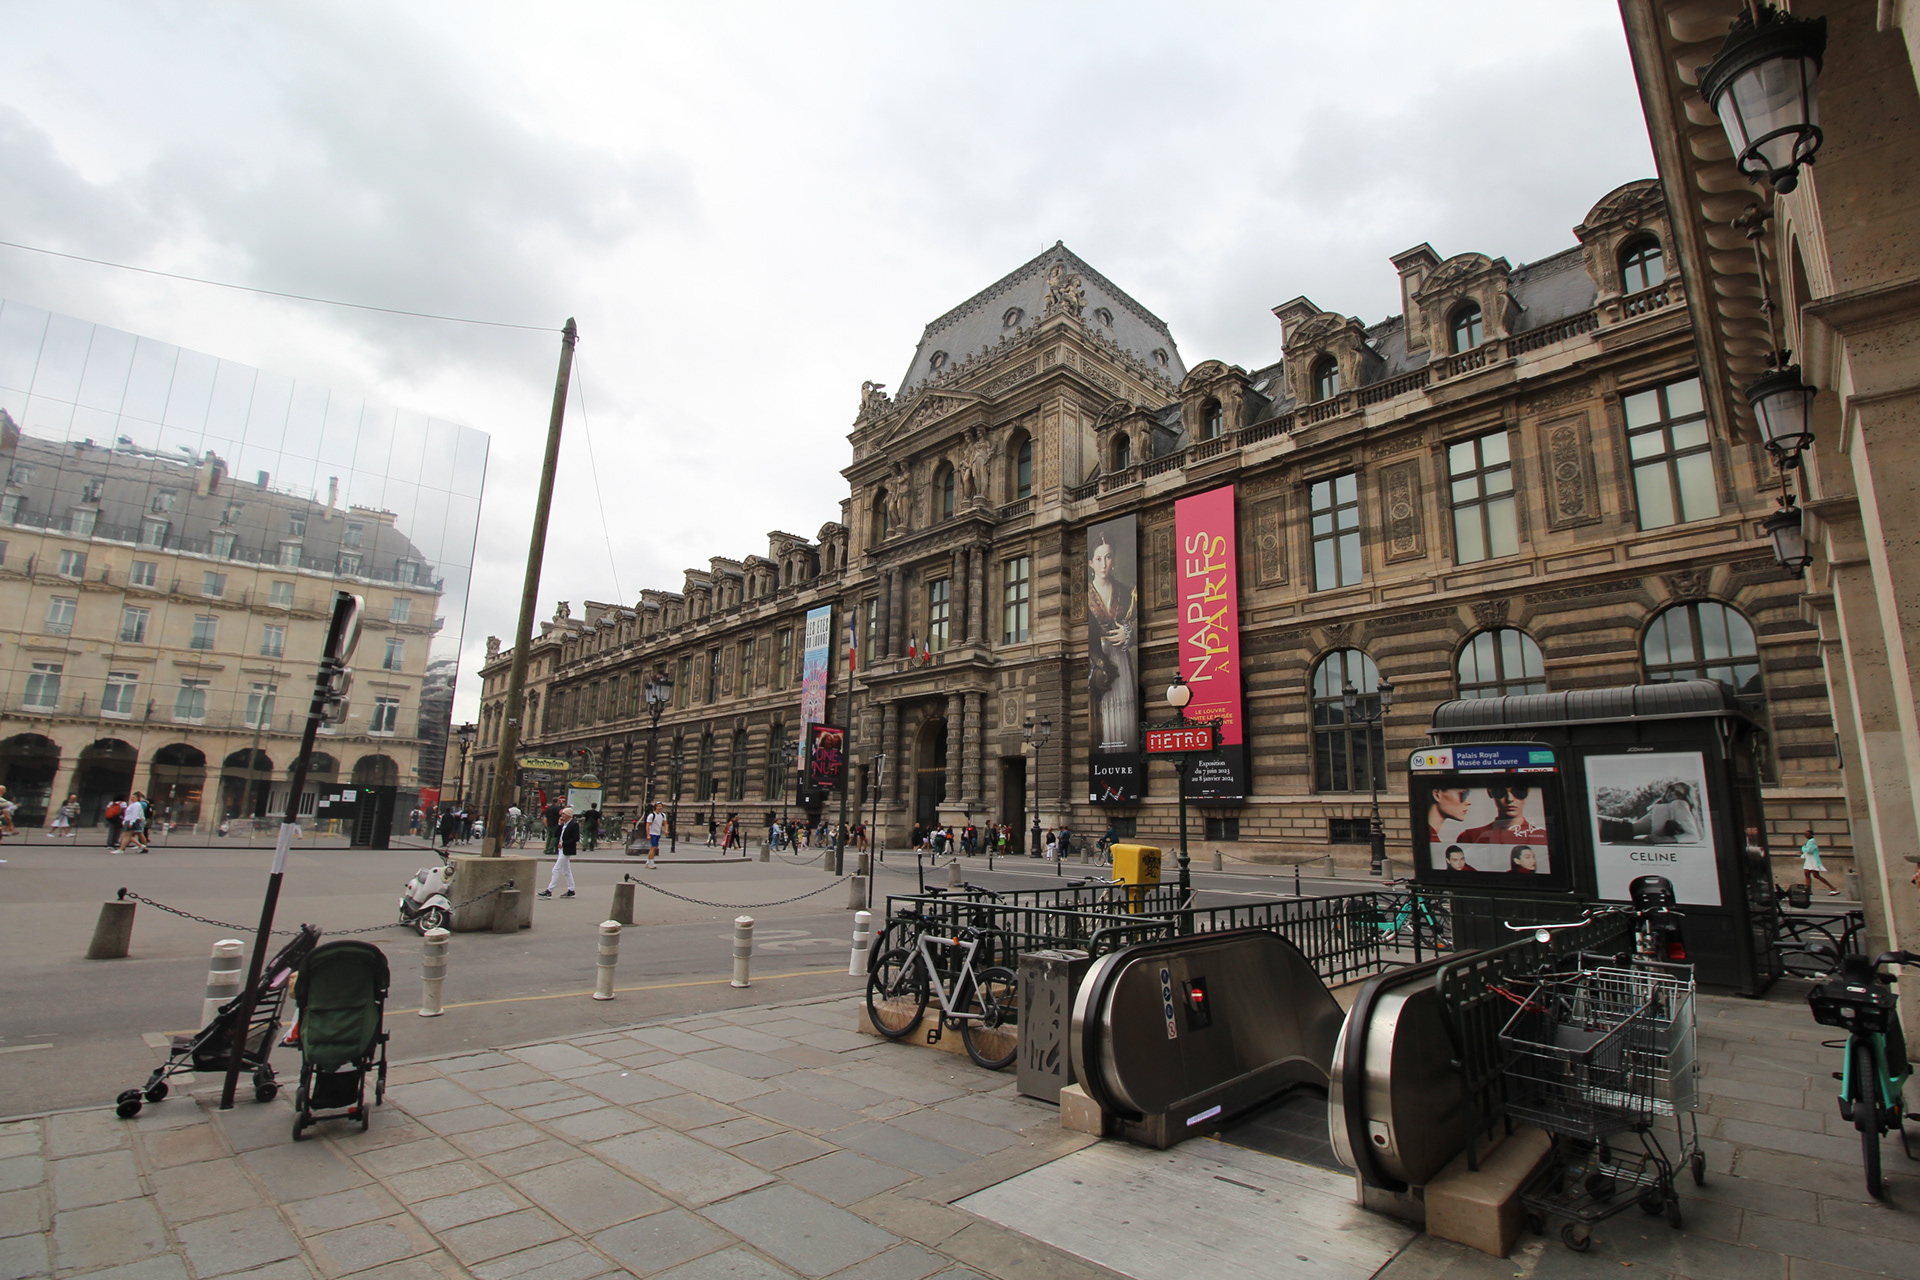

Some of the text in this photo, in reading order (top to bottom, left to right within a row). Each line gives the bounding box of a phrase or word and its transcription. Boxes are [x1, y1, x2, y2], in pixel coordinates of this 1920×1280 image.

[1202, 535, 1229, 656] PARIS
[1185, 531, 1213, 683] NAPLES
[806, 621, 815, 637] LES
[1203, 707, 1226, 715] LOUVRE
[1150, 731, 1208, 749] METRO
[816, 749, 839, 761] UNE
[1479, 751, 1499, 759] Royal
[1198, 760, 1226, 768] Exposition
[1206, 768, 1218, 776] juin
[1203, 775, 1221, 783] janvier
[1629, 851, 1678, 862] CELINE
